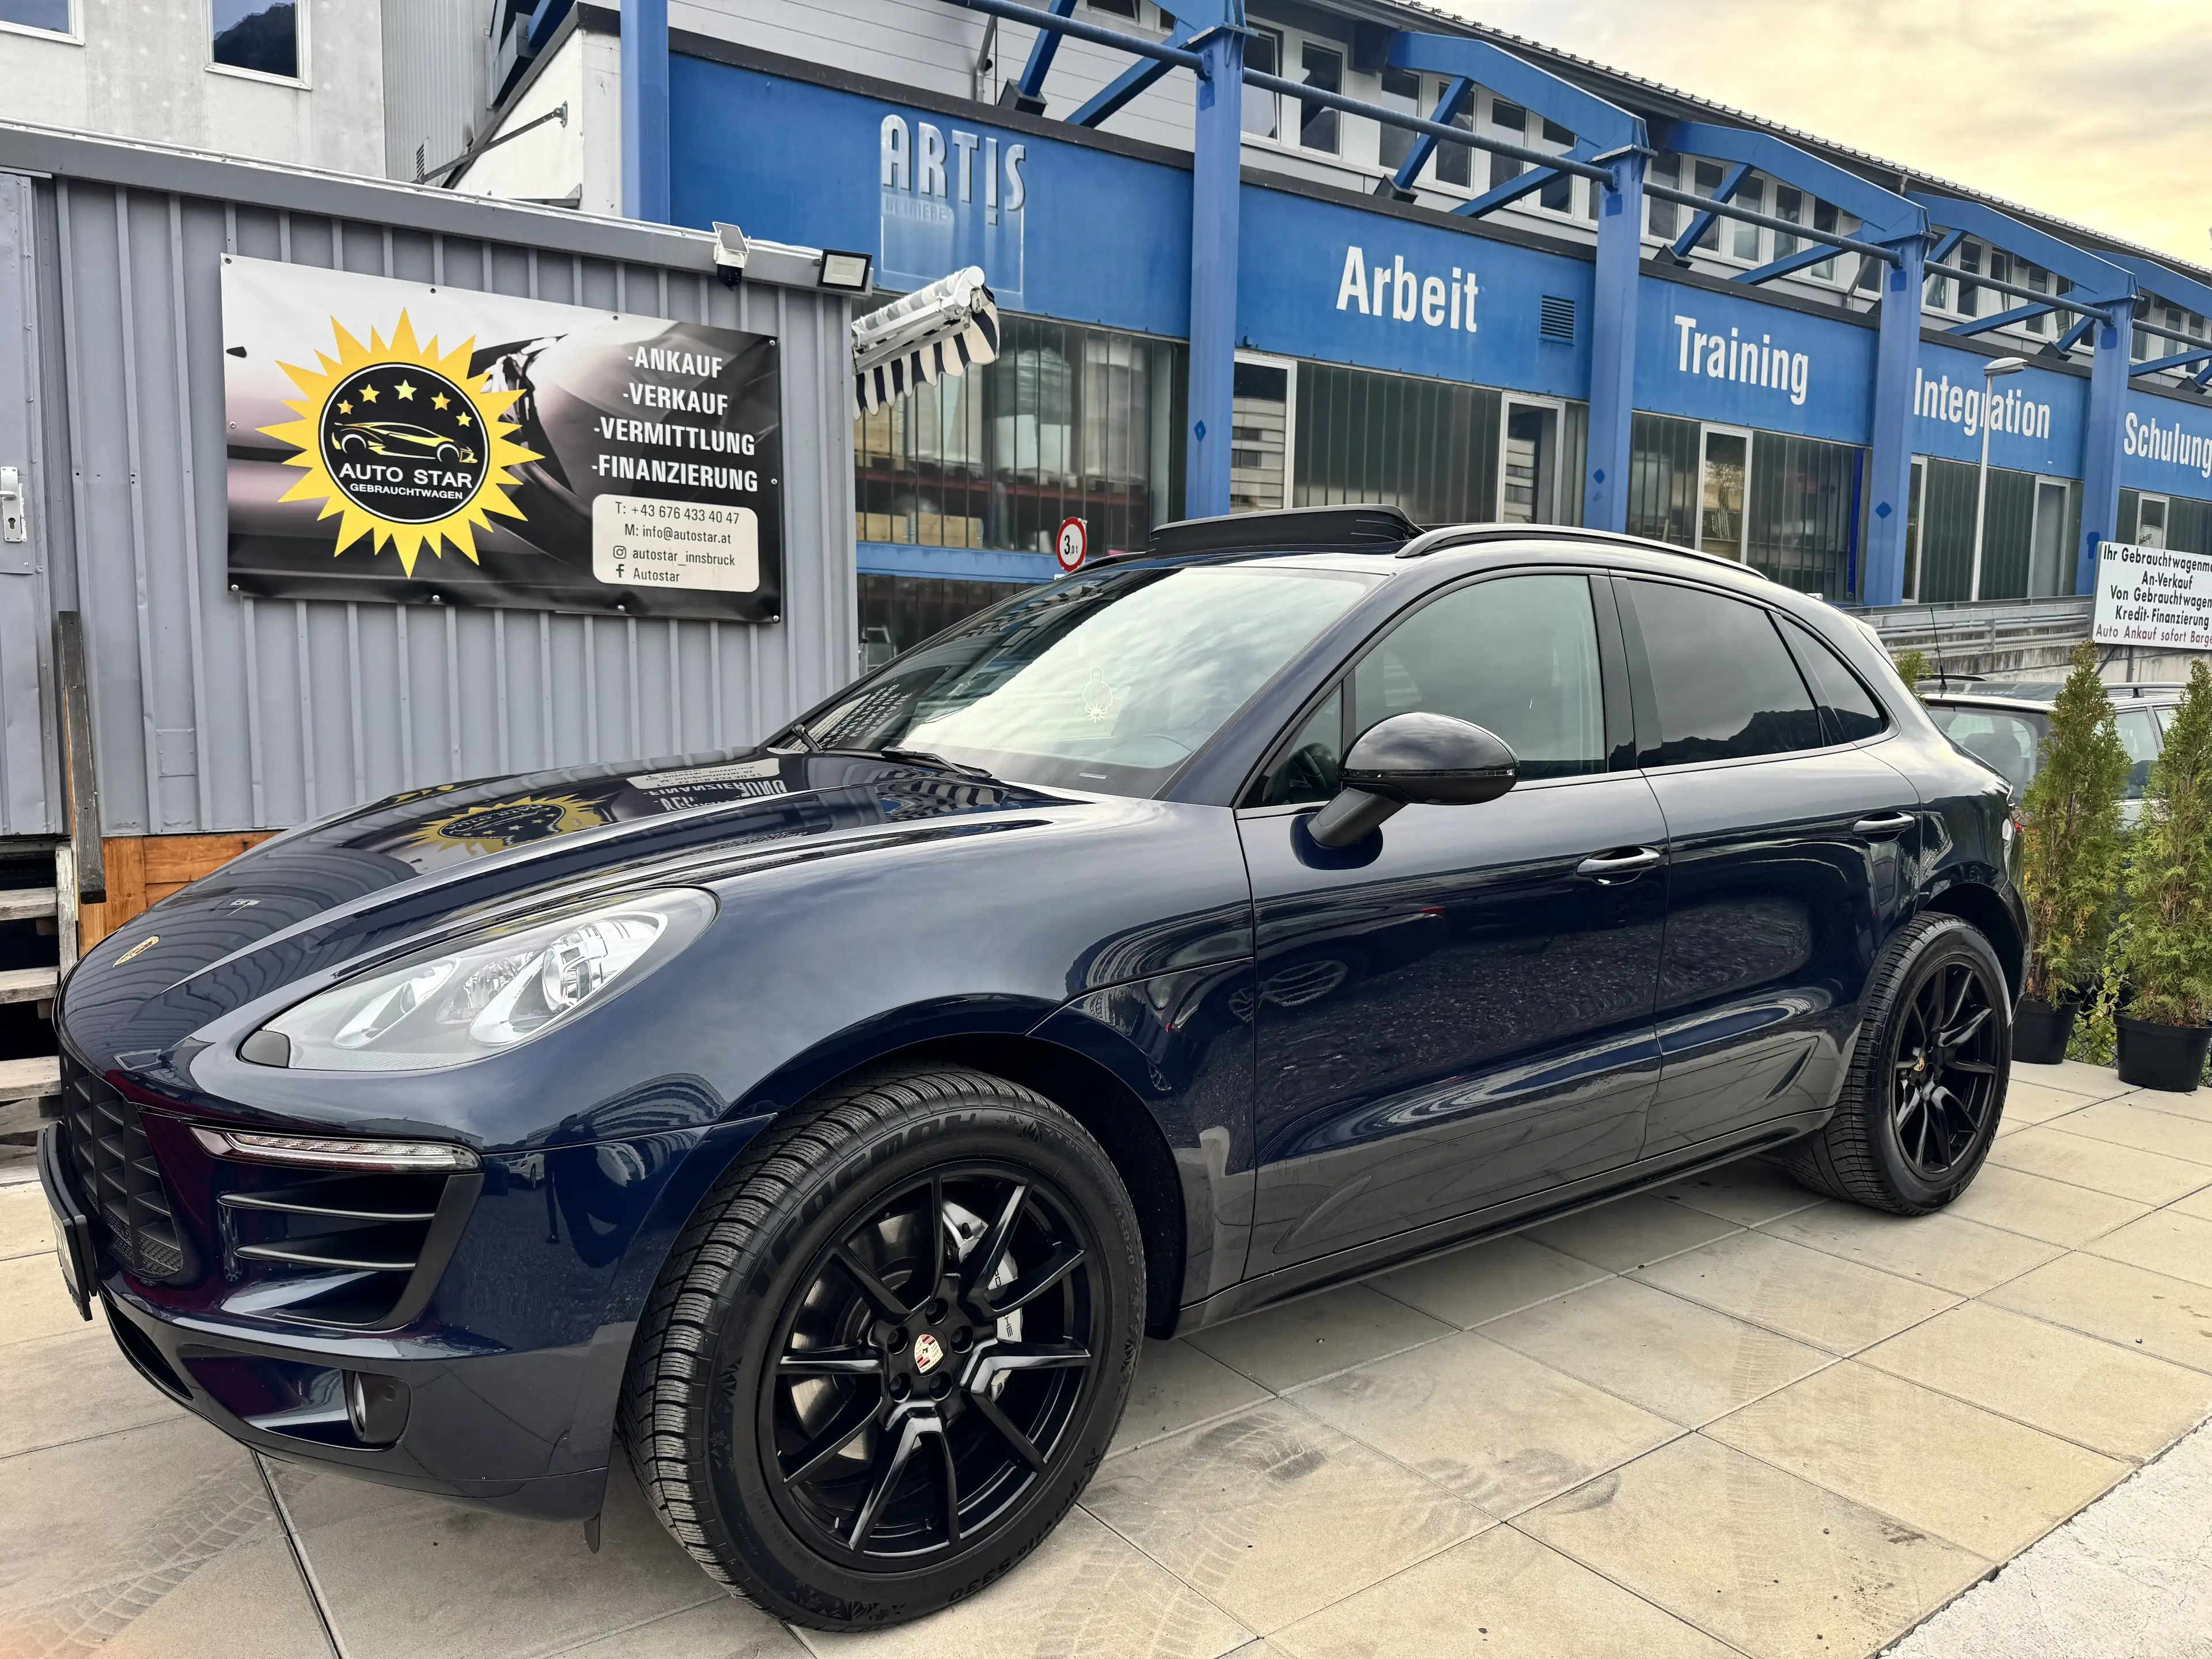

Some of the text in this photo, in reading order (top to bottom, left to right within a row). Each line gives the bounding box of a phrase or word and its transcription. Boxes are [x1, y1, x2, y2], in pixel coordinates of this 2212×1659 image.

[1336, 246, 1479, 333] Arbeit
[628, 346, 722, 378] -ANKAUF
[1675, 315, 1809, 406] Training
[623, 382, 728, 415] -VERKAUF
[1914, 368, 2050, 440] Integration
[594, 416, 755, 455] -VERMITTLUNG
[2123, 412, 2212, 478] Schulung
[339, 463, 472, 488] AUTO STAR
[592, 454, 757, 492] -FINANZIERUNG
[350, 483, 463, 499] GEBRAUCHTWAGEN
[615, 502, 739, 524] T: +43 676 433 40 47
[625, 524, 732, 544] M: info@autostar.at
[632, 549, 735, 566] autostar_innsbruck
[2104, 544, 2118, 561] Ihr
[633, 568, 680, 582] Autostar
[2141, 571, 2193, 590] An-Verkauf
[2111, 585, 2212, 611] Von Gebrauchtwagen
[2096, 623, 2118, 638] Auto
[2124, 626, 2157, 640] Ankauf
[2161, 628, 2186, 642] sofort
